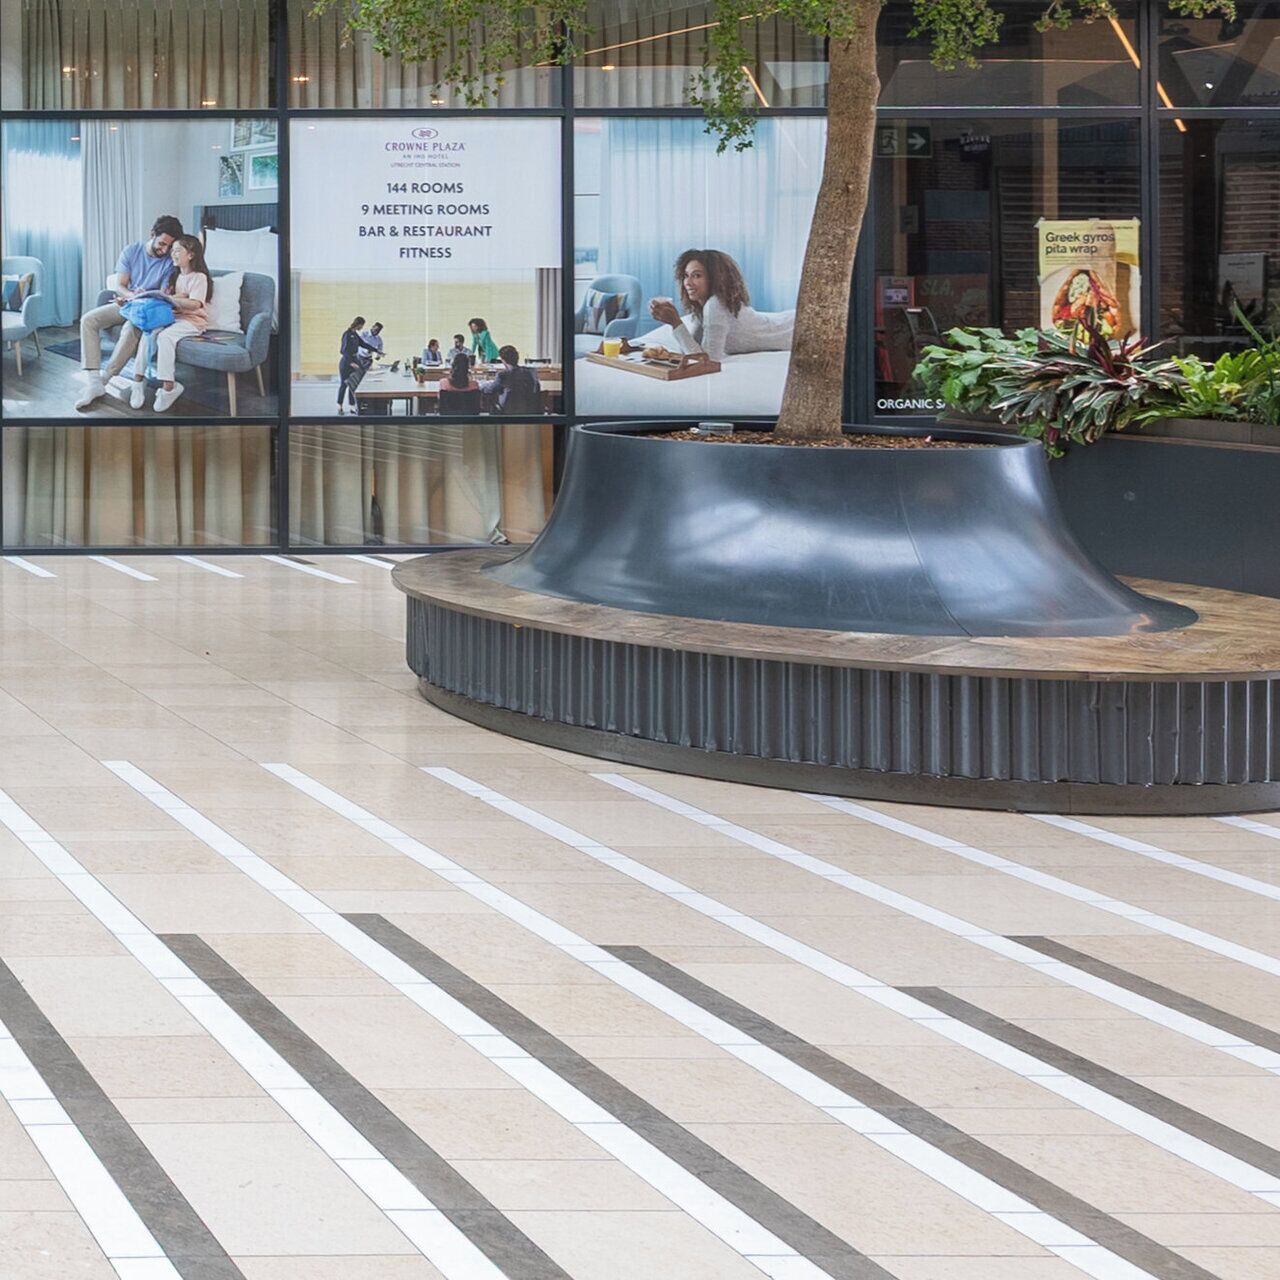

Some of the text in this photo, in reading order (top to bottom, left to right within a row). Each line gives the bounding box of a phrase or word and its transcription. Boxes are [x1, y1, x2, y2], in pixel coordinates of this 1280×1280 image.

[385, 142, 465, 151] CROWNE PLAZA
[387, 182, 464, 194] 144 ROOMS
[361, 204, 490, 216] 9 MEETING ROOMS
[359, 225, 492, 237] BAR & RESTAURANT
[1045, 232, 1115, 244] Greek gyros
[399, 247, 452, 259] FITNESS
[1045, 243, 1098, 255] pita wrap
[877, 399, 933, 409] ORGANIC
